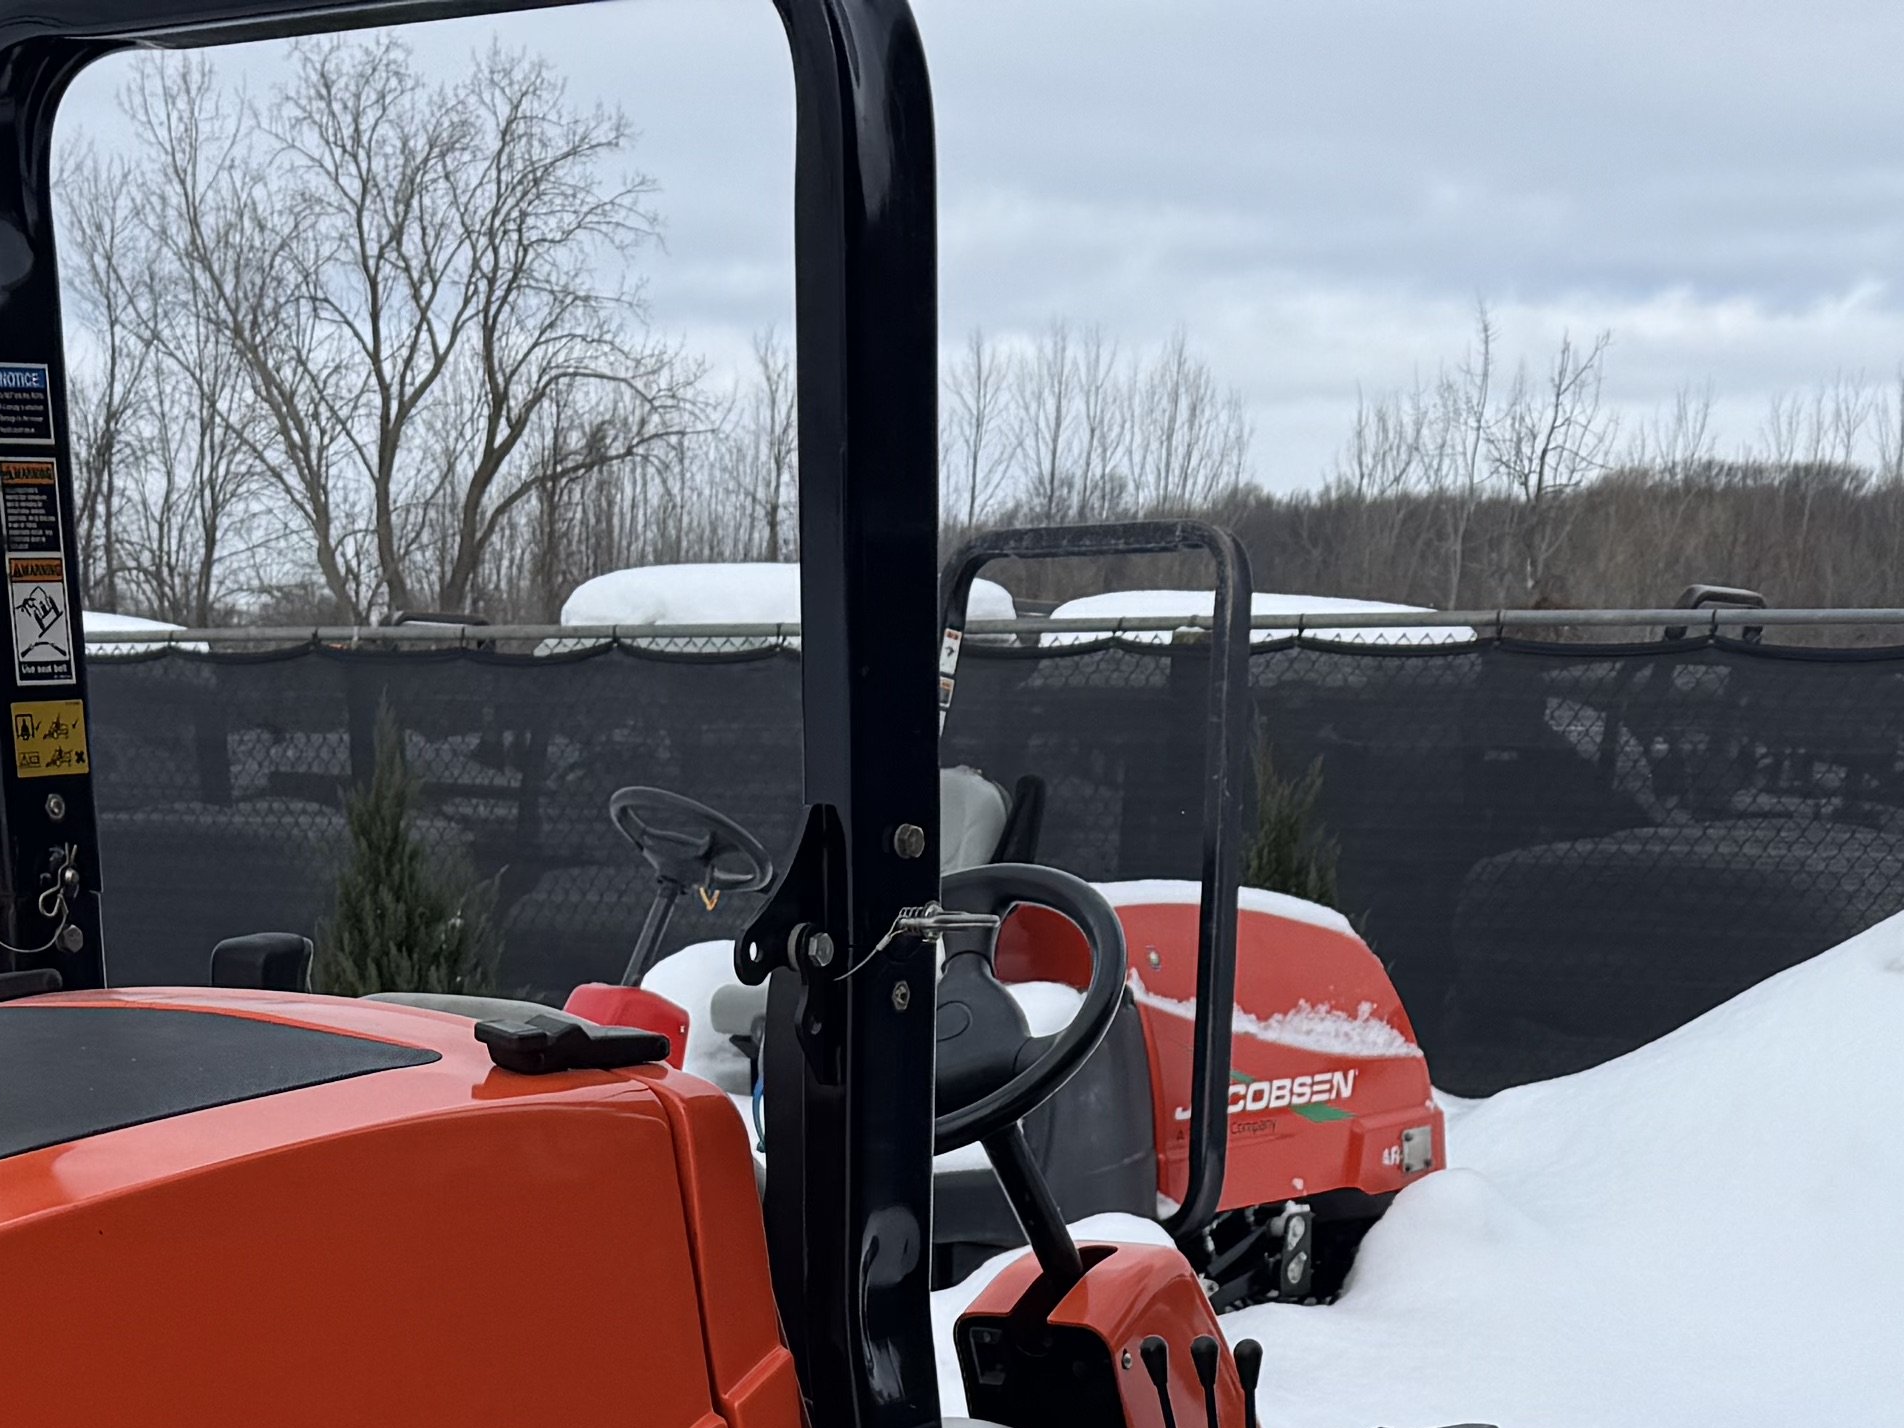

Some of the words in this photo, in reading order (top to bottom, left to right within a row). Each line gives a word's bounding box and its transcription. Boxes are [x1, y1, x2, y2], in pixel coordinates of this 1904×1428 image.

[0, 371, 39, 388] NOTICE
[1174, 1068, 1356, 1121] JCOBSEN
[1231, 1119, 1278, 1135] Company
